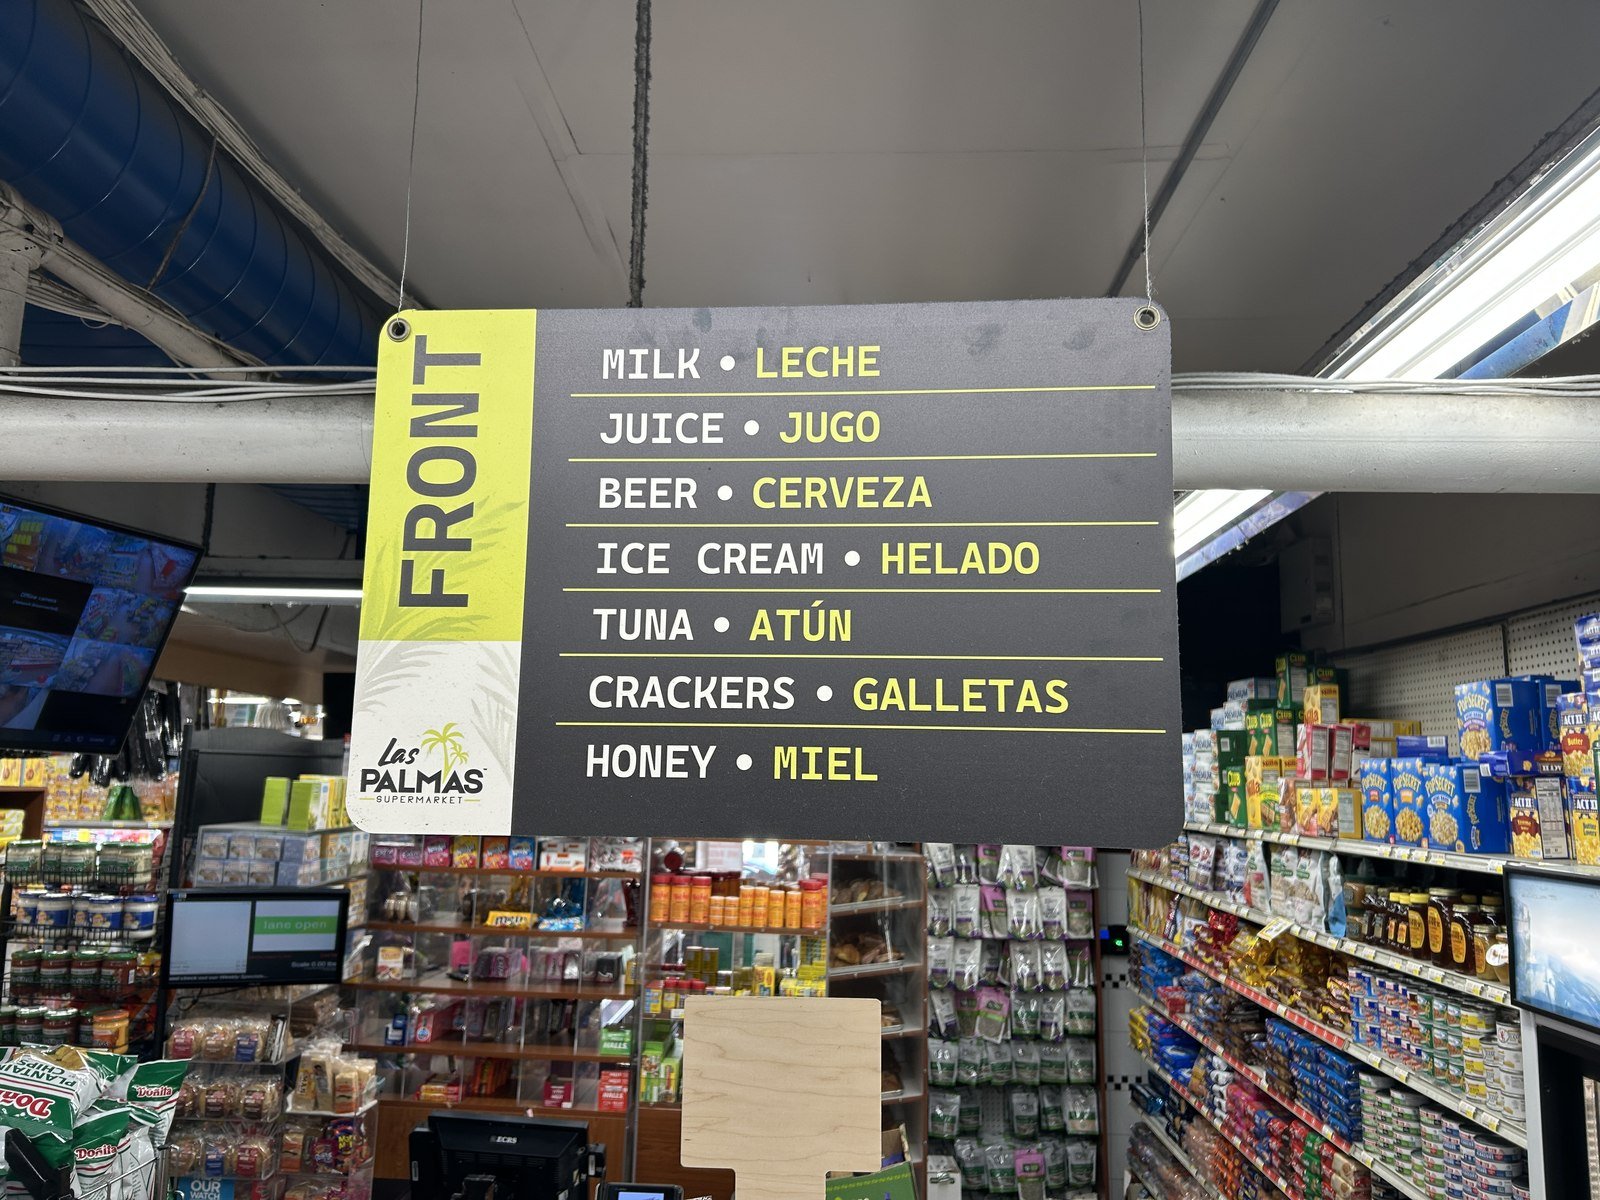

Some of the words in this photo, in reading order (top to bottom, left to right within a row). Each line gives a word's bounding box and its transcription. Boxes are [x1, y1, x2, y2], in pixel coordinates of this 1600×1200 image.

[602, 348, 701, 381] MILK
[755, 344, 881, 379] LECHE
[600, 412, 725, 445] JUICE
[779, 410, 881, 444] JUGO
[398, 334, 482, 608] FRONT
[598, 477, 698, 509] BEER
[752, 475, 933, 509] CERVEZA
[596, 542, 671, 575] ICE
[697, 542, 824, 575] CREAM
[881, 541, 1040, 575] HELADO
[592, 608, 694, 641] TUNA
[748, 600, 852, 642] ATÚN
[589, 675, 795, 710] CRACKERS
[853, 677, 1069, 714] GALLETAS
[1563, 715, 1575, 726] ACT
[377, 737, 421, 767] Las
[1567, 737, 1583, 746] Butter
[586, 744, 717, 779] HONEY
[773, 746, 878, 781] MIEL
[360, 768, 484, 794] PALMAS
[375, 795, 463, 804] SUPERMARKET
[1515, 797, 1525, 807] ACT
[1577, 799, 1589, 810] ACT
[263, 920, 291, 930] lane
[295, 921, 327, 931] open
[17, 1059, 65, 1075] CHIPS
[0, 1089, 56, 1119] Doñ
[496, 1136, 517, 1144] ECRS
[75, 1144, 118, 1161] Doñita
[190, 1179, 221, 1192] OUR
[190, 1191, 221, 1200] WATCH
